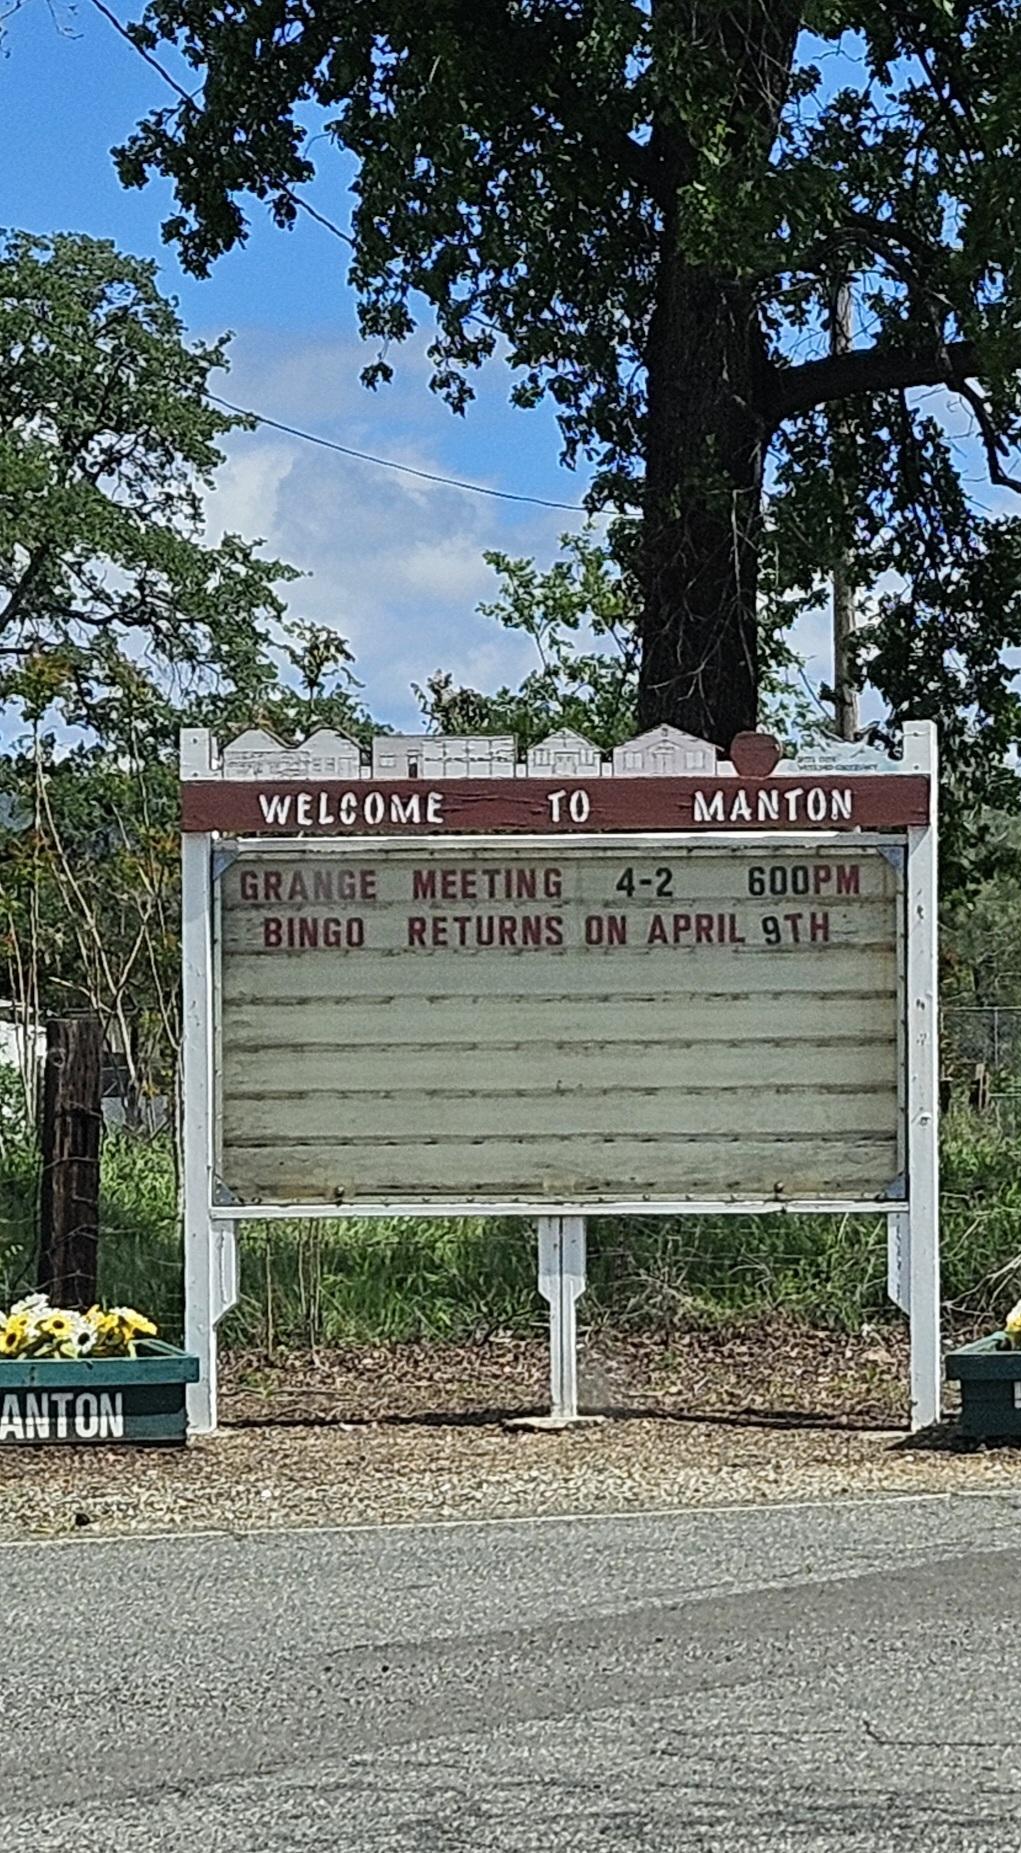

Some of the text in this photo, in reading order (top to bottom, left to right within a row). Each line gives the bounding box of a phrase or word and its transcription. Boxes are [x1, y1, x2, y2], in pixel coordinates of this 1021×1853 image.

[258, 786, 853, 826] WELCOME TO MANTON
[239, 864, 861, 901] GRANGE MEETING 4-2 600PM
[263, 911, 830, 948] BINGO RETURNS ON APRIL 9TH
